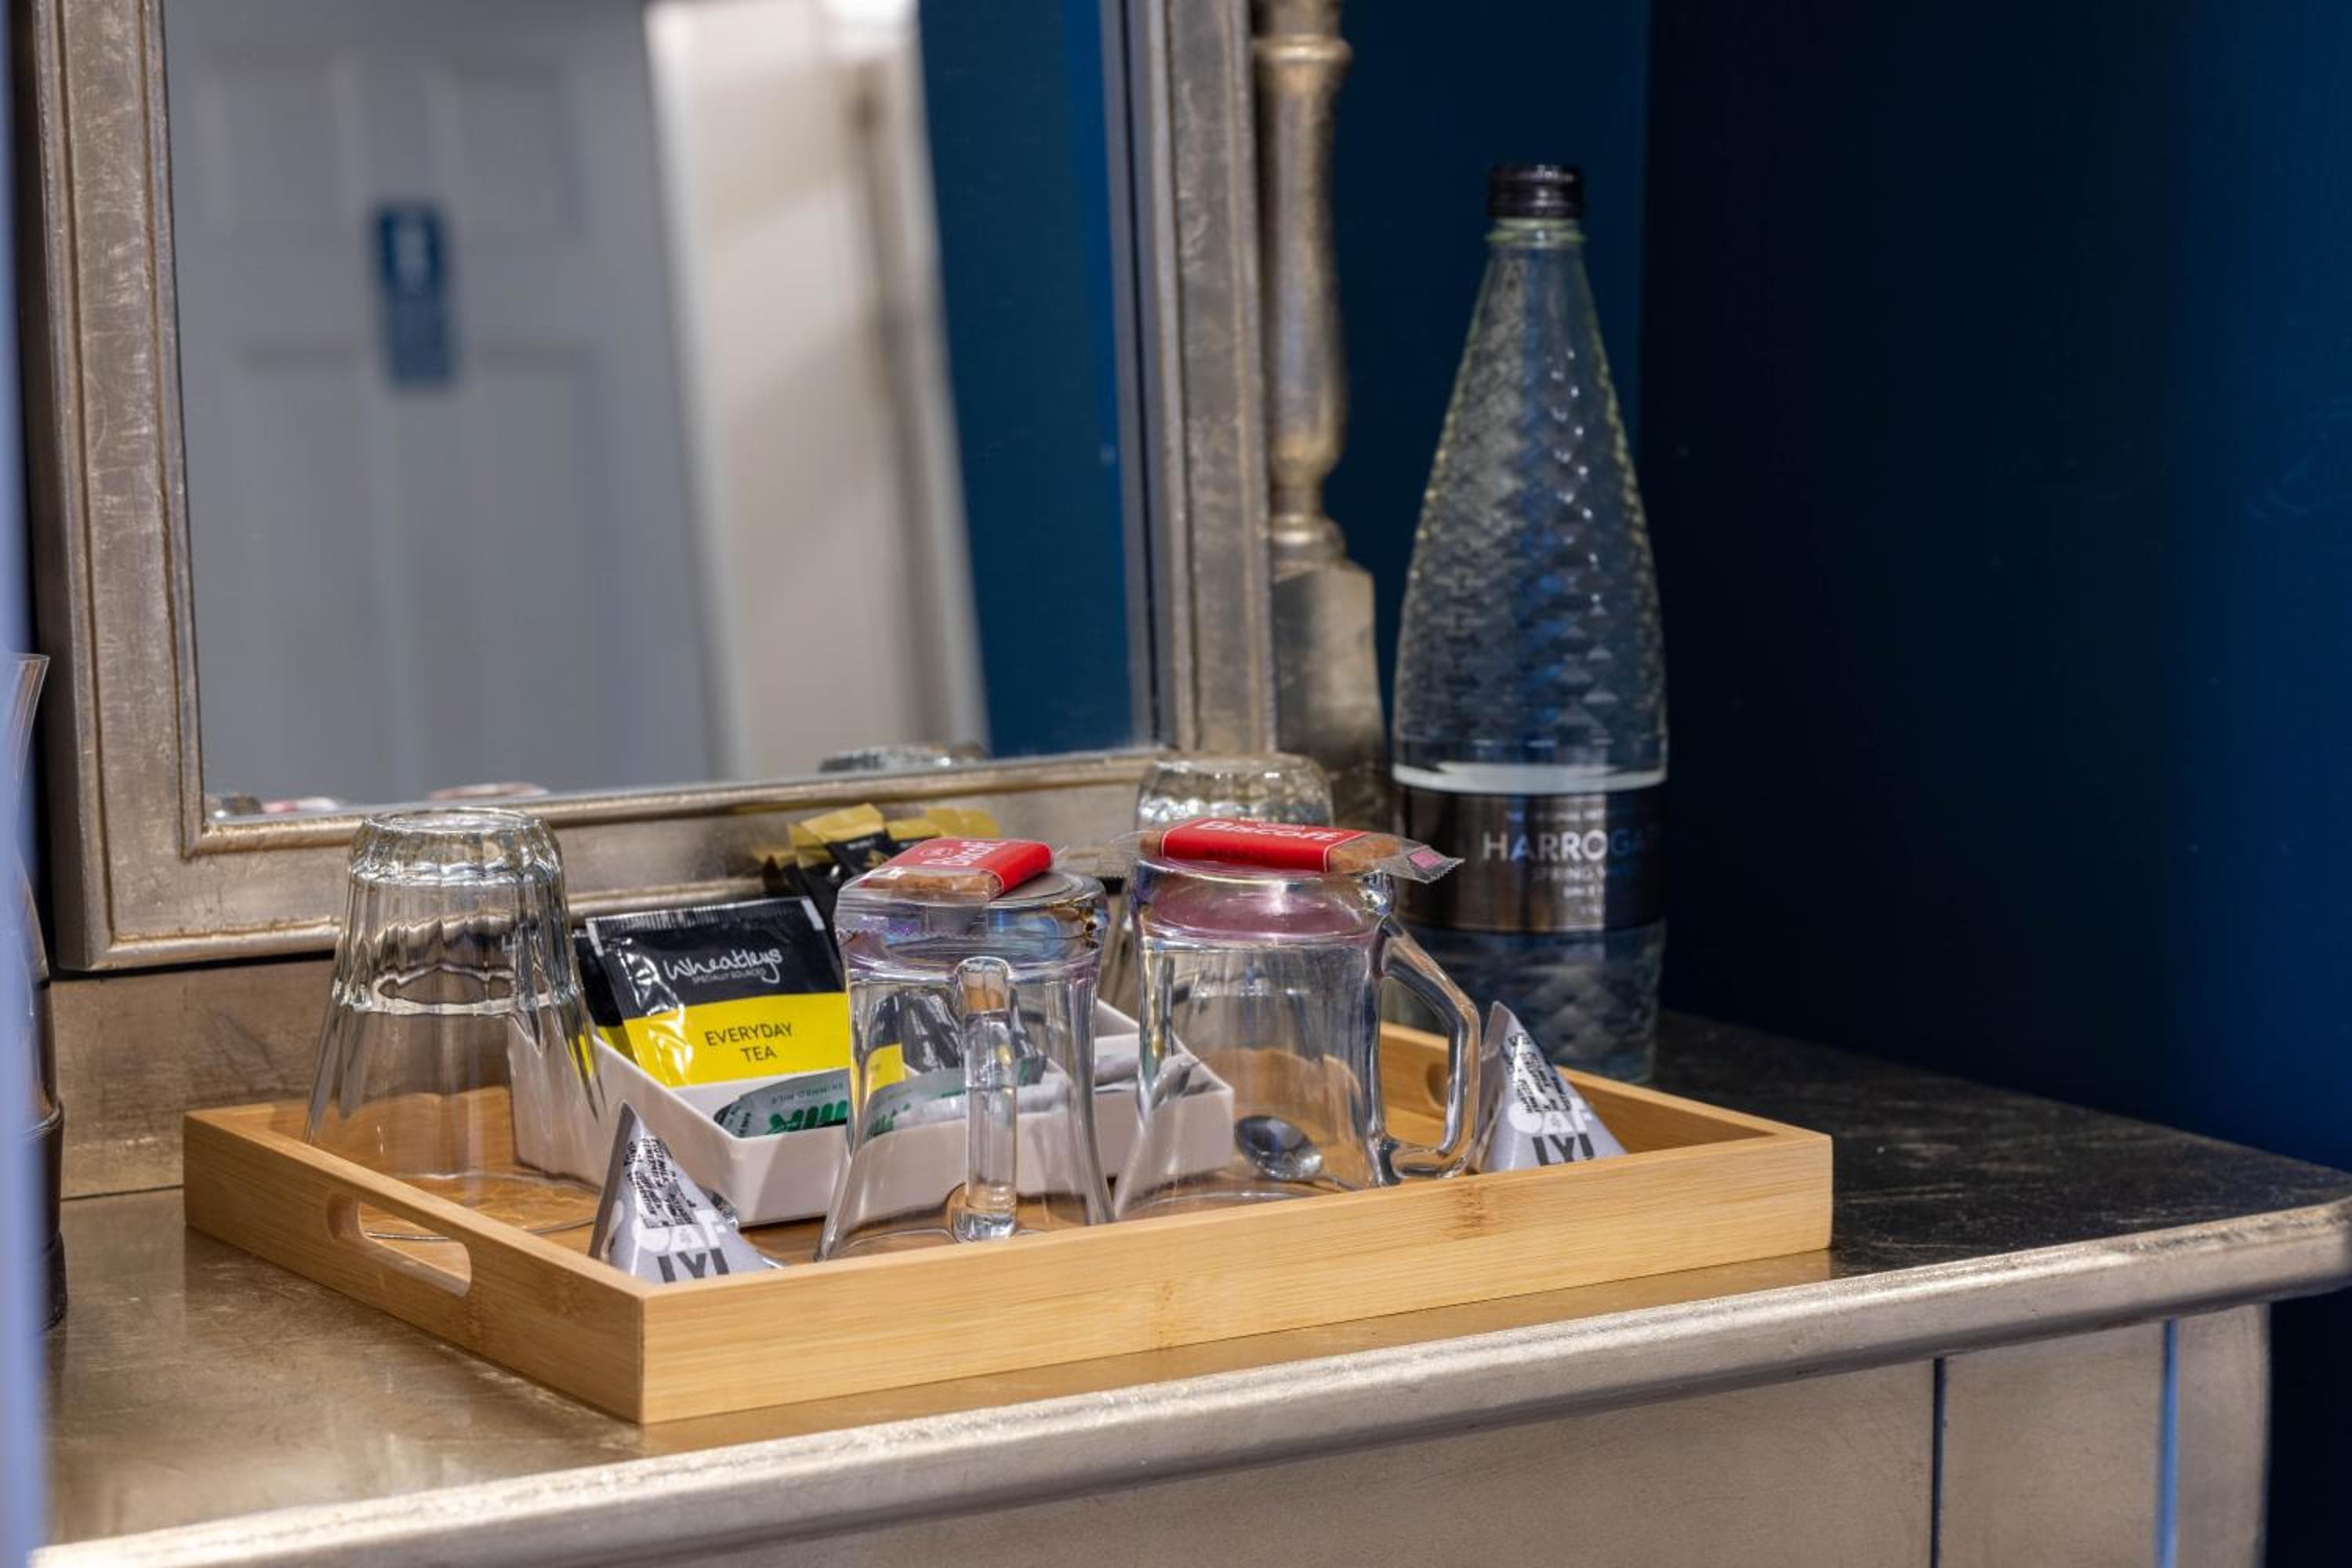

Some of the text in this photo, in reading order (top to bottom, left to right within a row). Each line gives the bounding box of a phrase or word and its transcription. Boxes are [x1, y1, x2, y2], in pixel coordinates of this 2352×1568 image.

[1481, 829, 1646, 862] HARROG
[663, 948, 783, 985] Wheatleys
[704, 1023, 793, 1047] EVERYDAY
[741, 1047, 777, 1063] TEA
